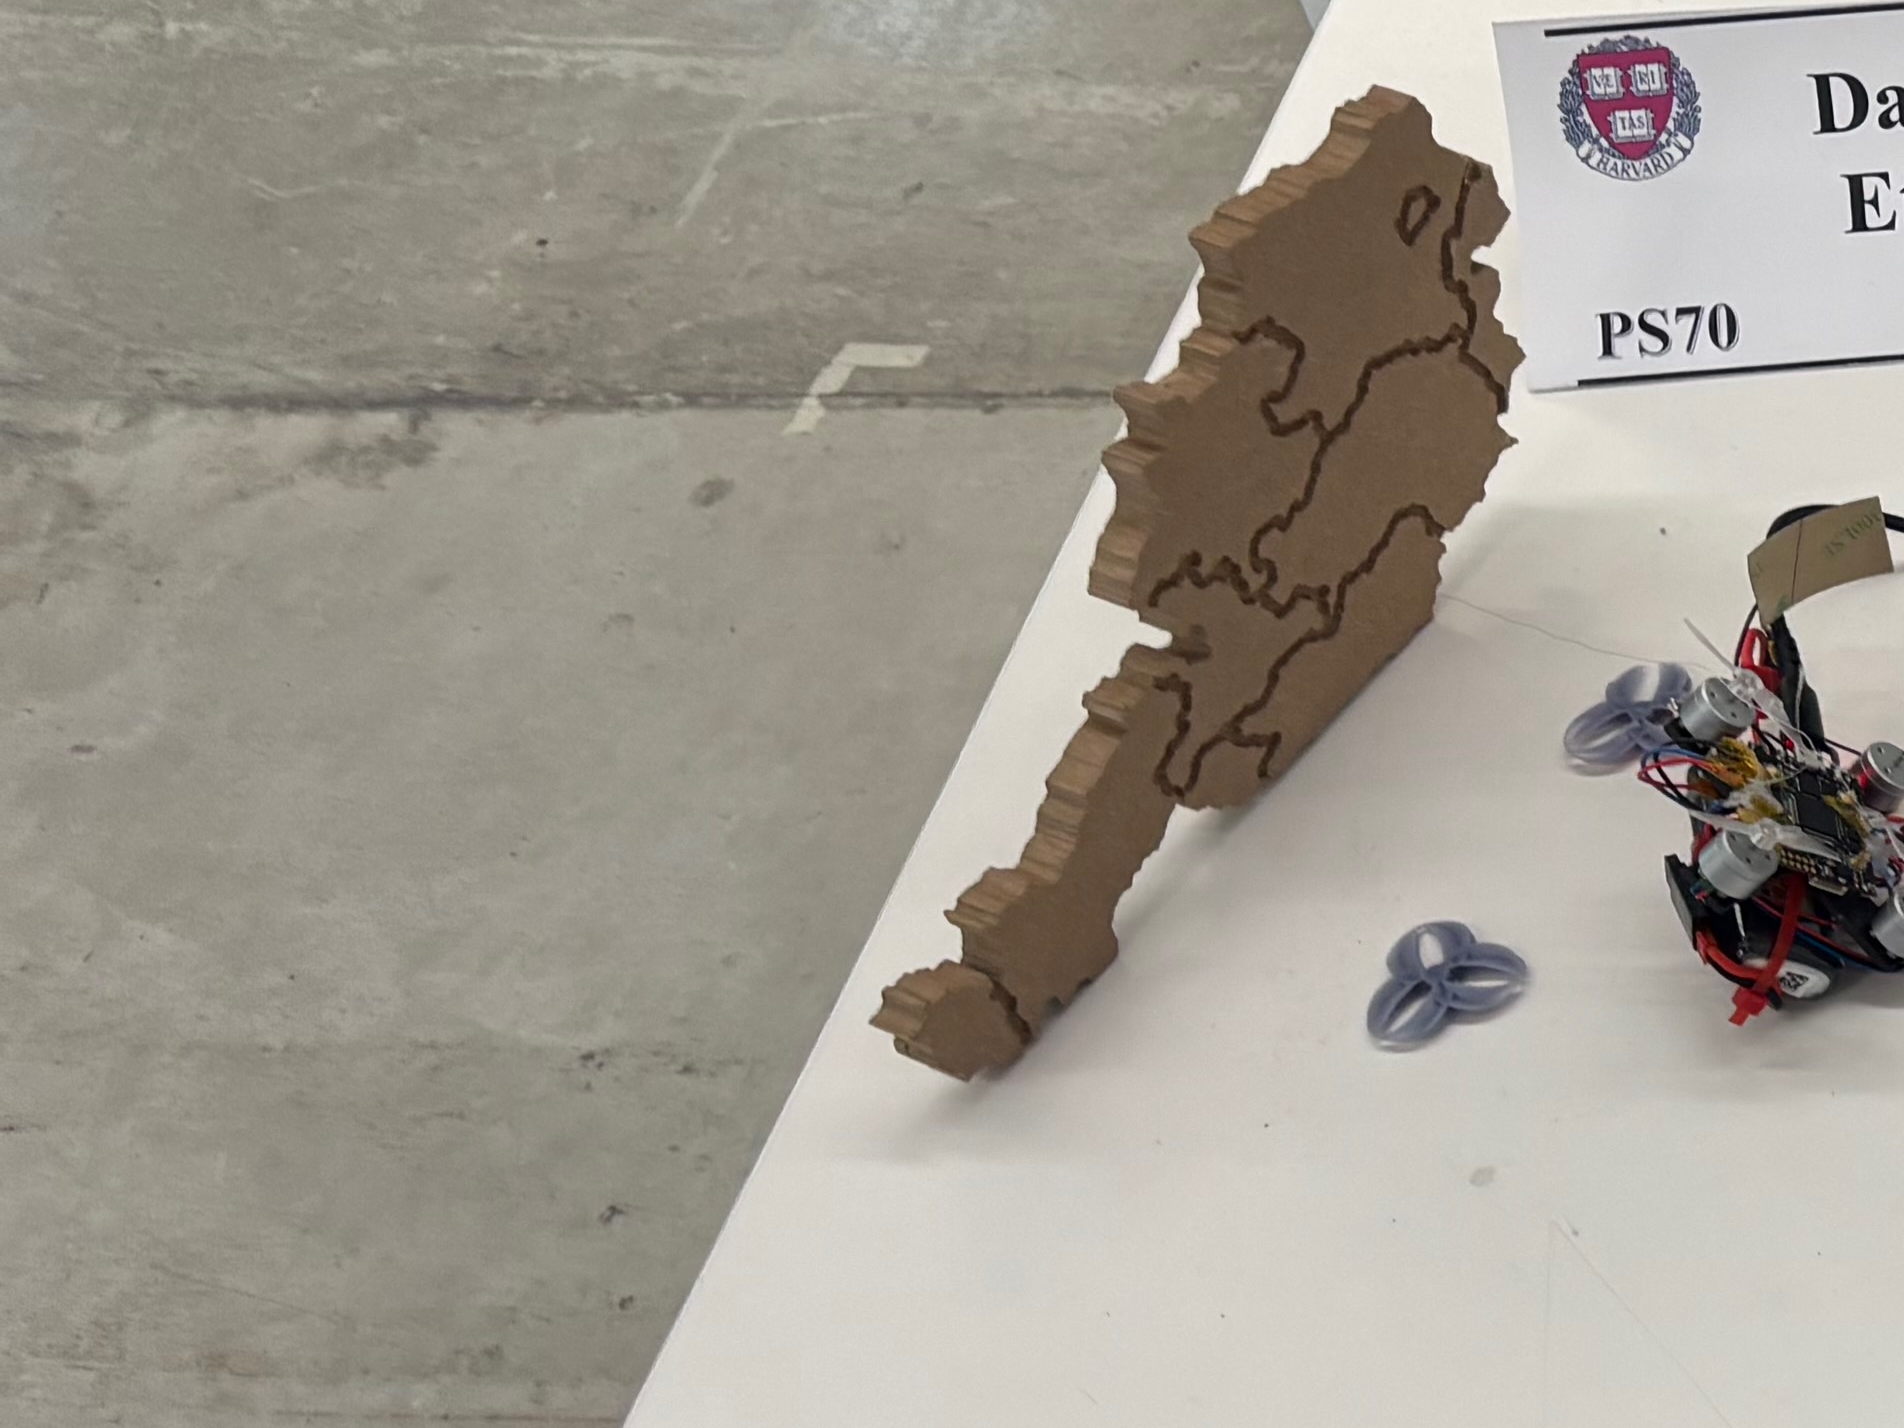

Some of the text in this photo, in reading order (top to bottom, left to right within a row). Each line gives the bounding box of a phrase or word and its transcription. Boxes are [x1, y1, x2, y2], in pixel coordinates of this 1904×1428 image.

[1618, 115, 1646, 132] TAS
[1597, 151, 1674, 180] HARVARD
[1597, 303, 1741, 359] PS70
